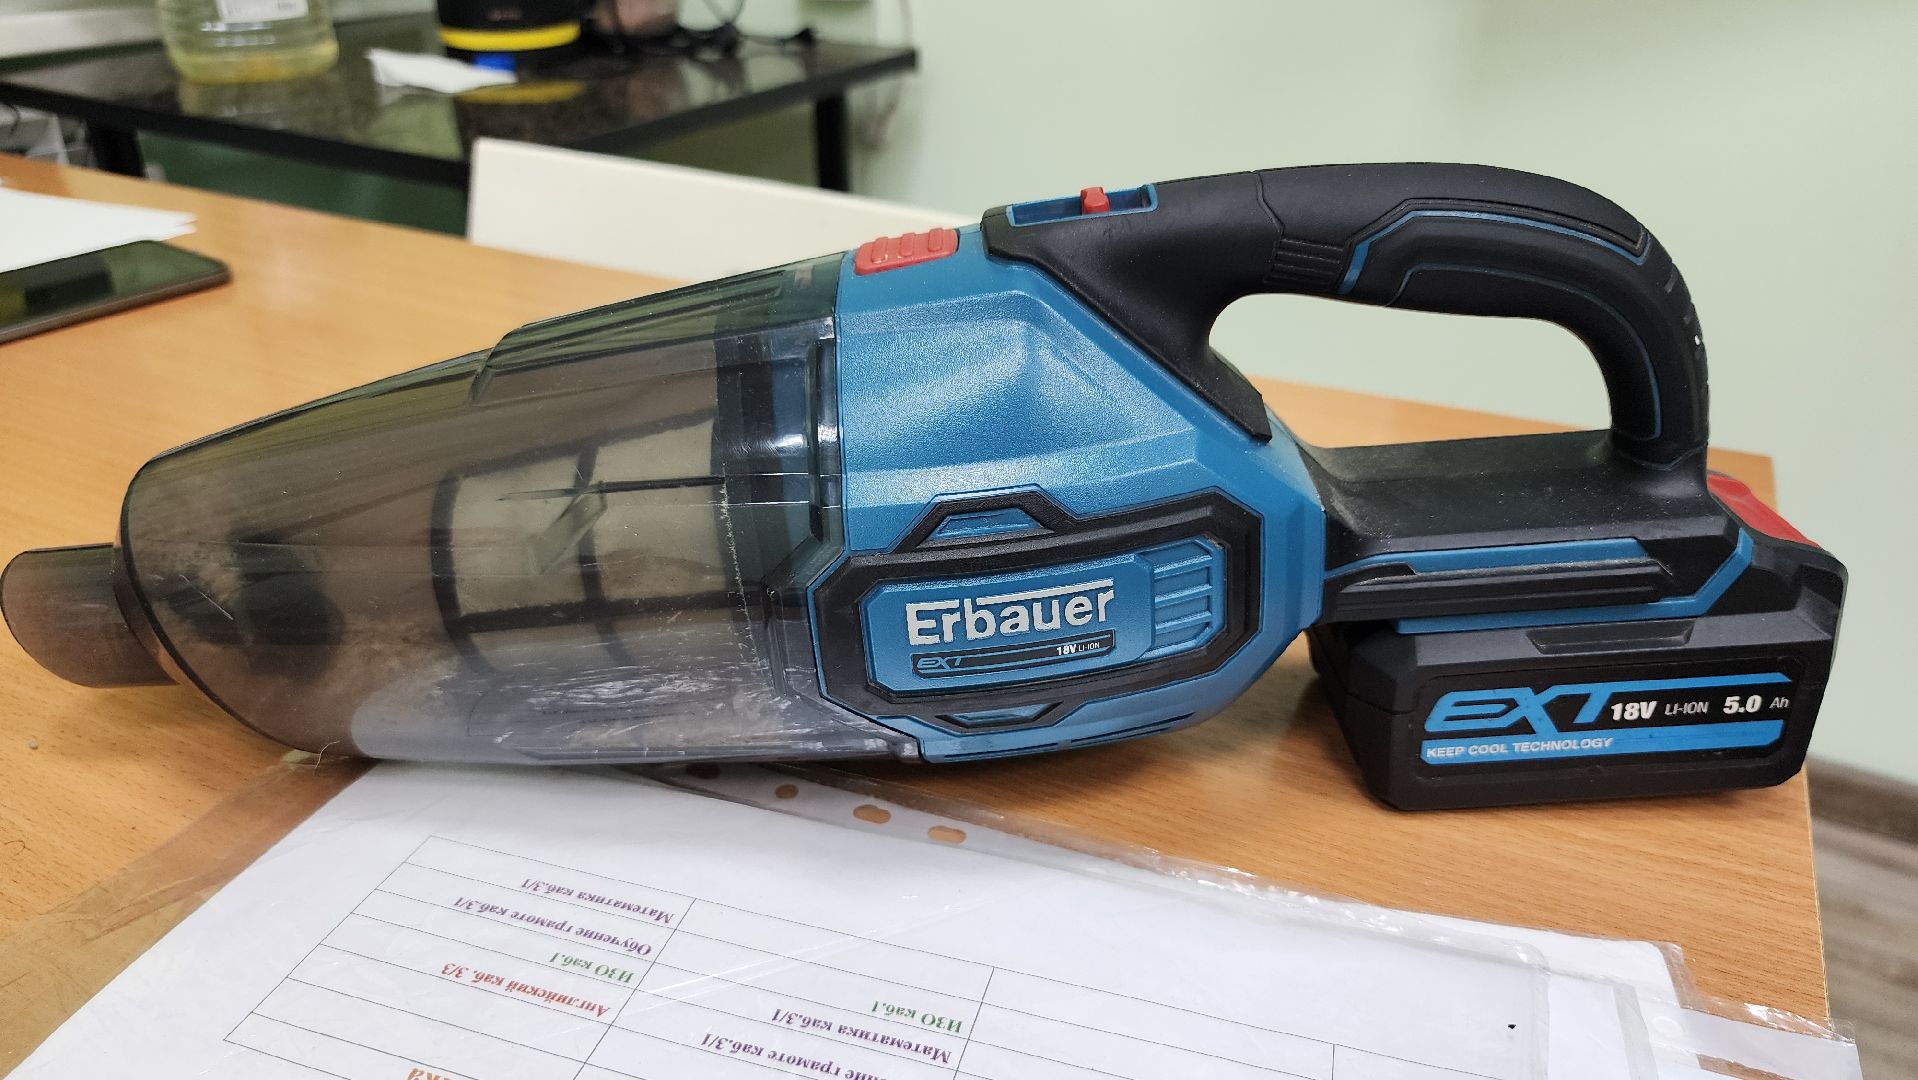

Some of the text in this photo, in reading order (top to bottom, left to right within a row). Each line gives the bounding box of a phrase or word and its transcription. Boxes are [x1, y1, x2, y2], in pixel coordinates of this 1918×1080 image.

[905, 578, 1115, 646] Erbauer
[916, 655, 963, 670] EXT
[1056, 641, 1100, 656] 18V LI-ION
[1424, 683, 1790, 735] EXT 18V LI-ION 5.0 Ah
[1426, 737, 1614, 758] KEEP COOL TECHNOLOGY
[521, 878, 675, 924] Математика каб.3/1
[454, 896, 653, 957] Обучение грамоте каб.3/1
[549, 952, 635, 984] ИЗО каб.1
[441, 963, 611, 1018] Английский каб. 3/3
[871, 1001, 963, 1033] ИЗО каб.1
[701, 1033, 764, 1057] каб.3/1
[772, 1009, 952, 1064] Математика каб.3/1
[767, 1051, 841, 1077] грамоте
